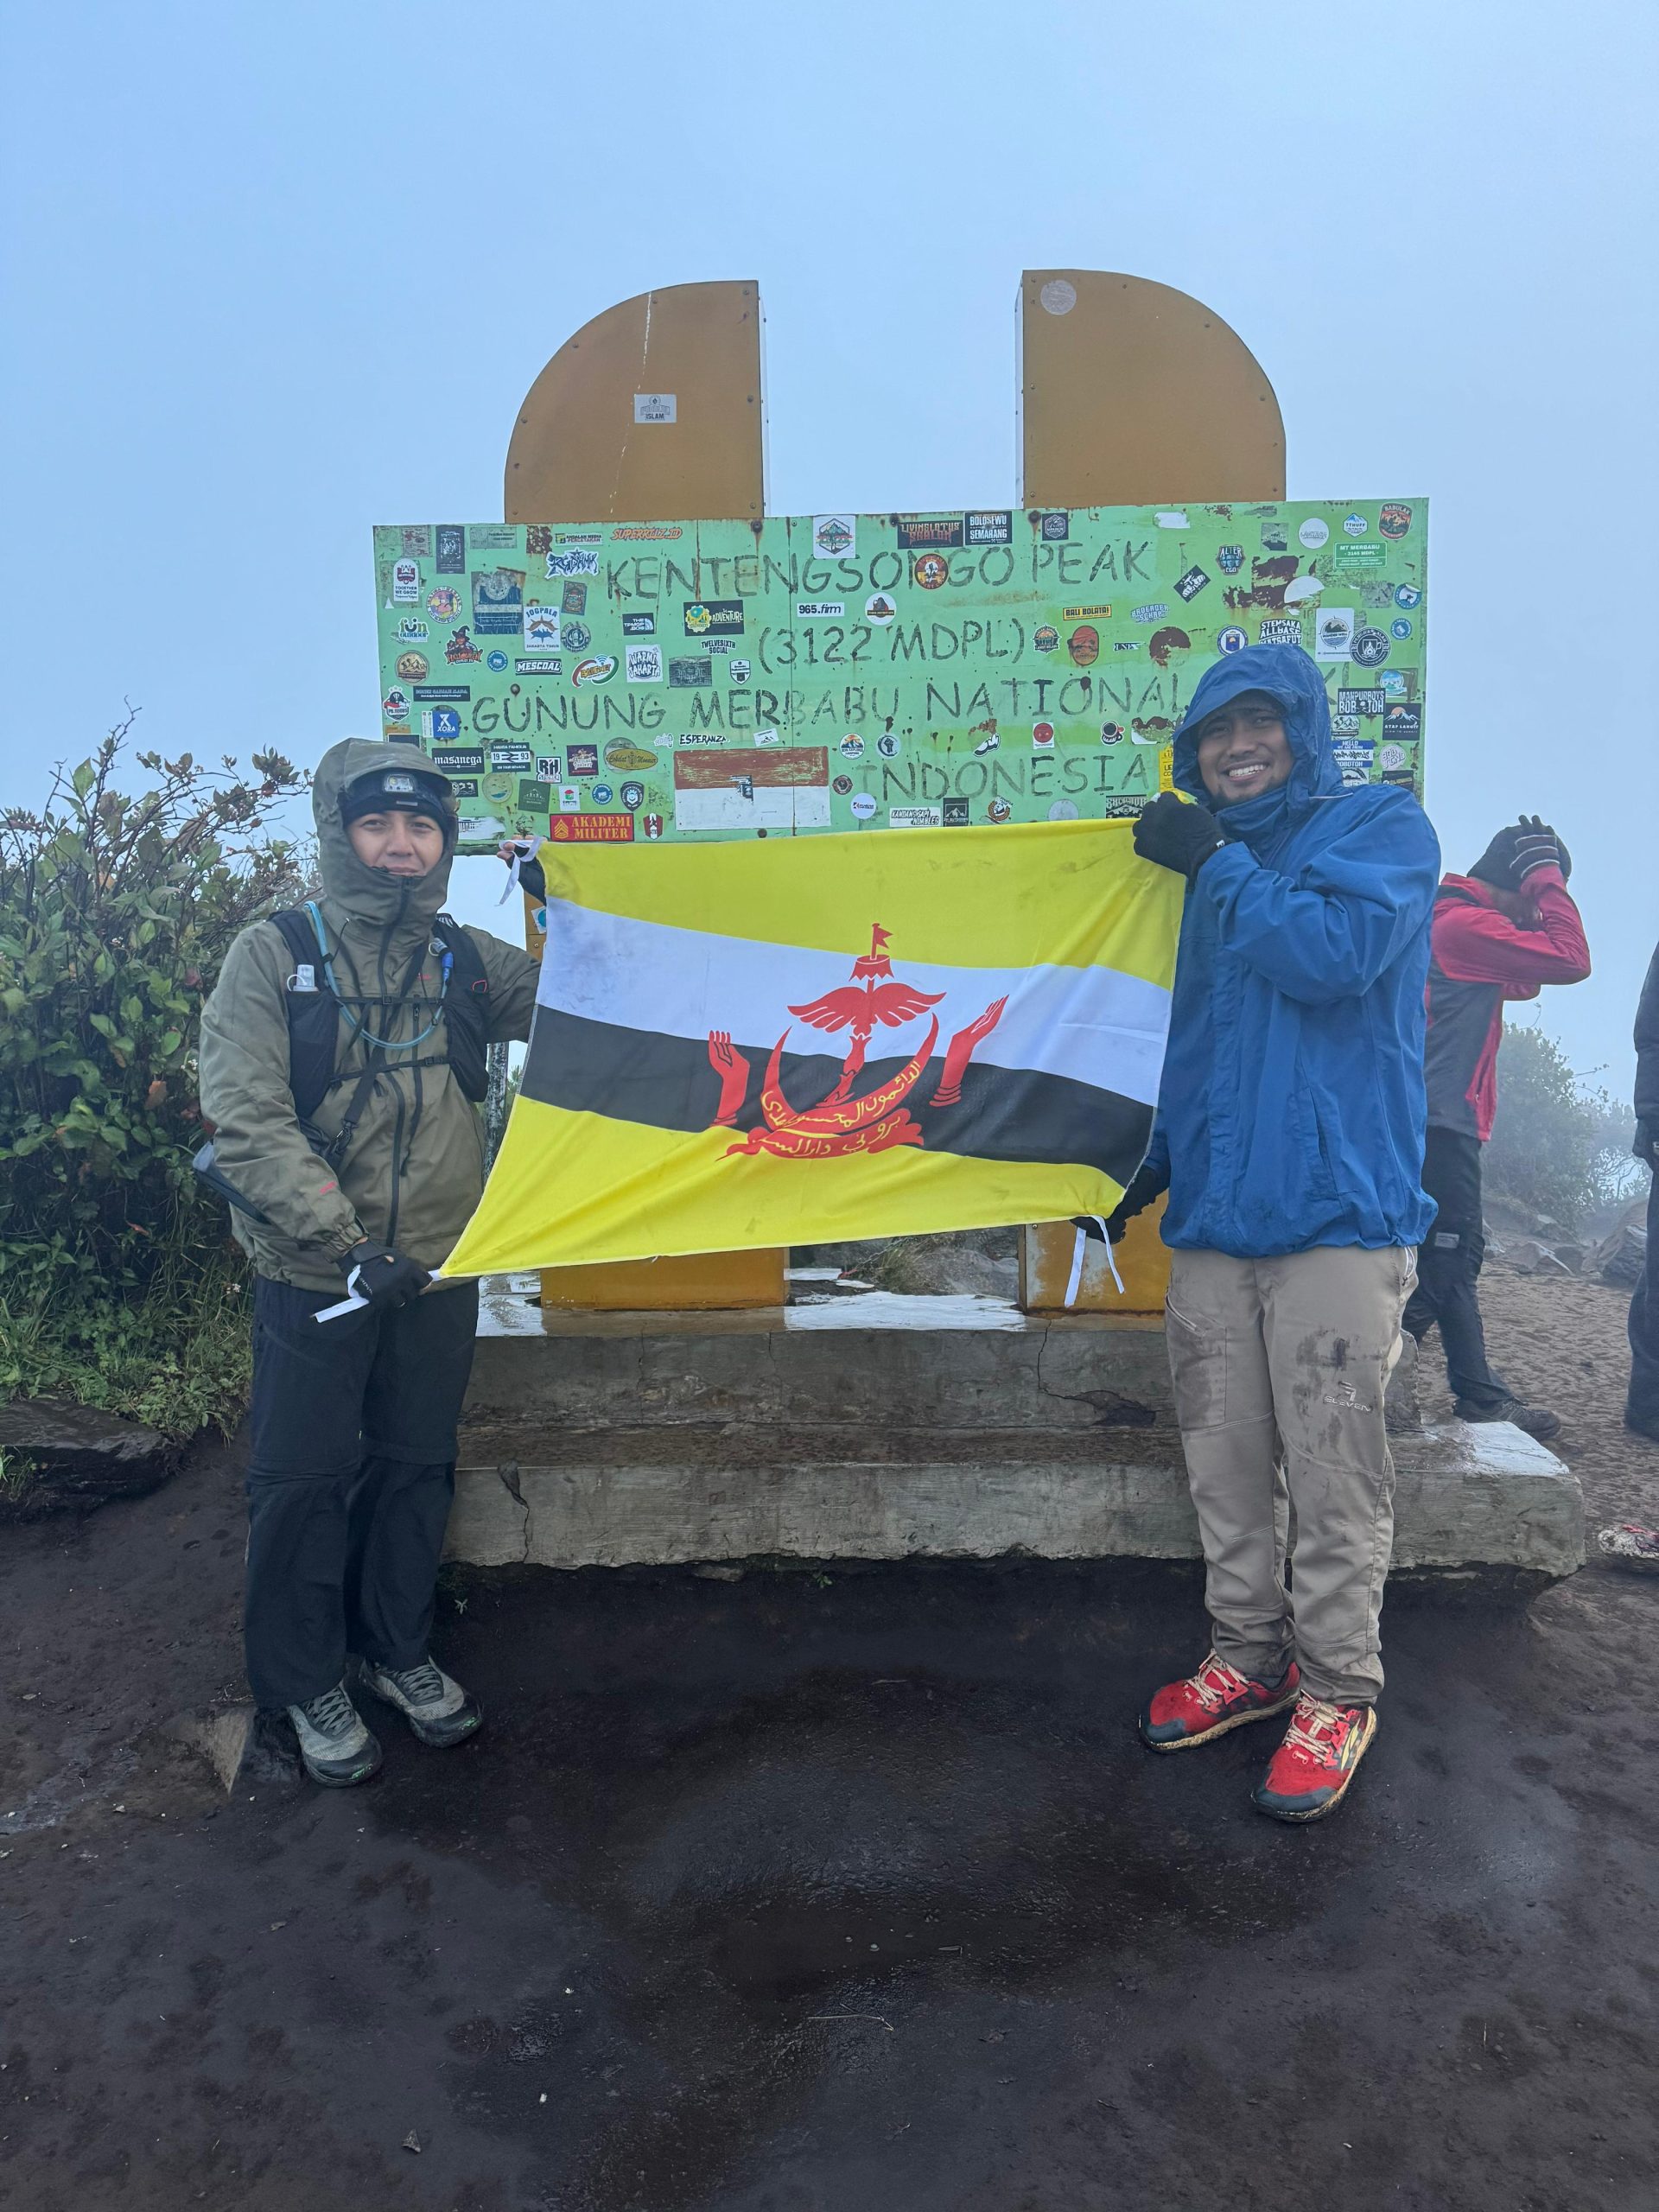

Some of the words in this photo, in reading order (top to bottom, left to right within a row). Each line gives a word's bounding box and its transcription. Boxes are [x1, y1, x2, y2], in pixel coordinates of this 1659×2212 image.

[969, 515, 1007, 526] BOLOSEWU
[969, 528, 1008, 540] SEMARANG
[1220, 545, 1243, 557] ALTER
[1032, 541, 1151, 586] PEAK
[798, 604, 842, 615] 965.firm
[1082, 607, 1109, 616] BOLATA!
[712, 610, 744, 623] ADVENTURE
[1261, 620, 1301, 631] STEMSAKA
[701, 639, 736, 649] TWELVESIXTH
[758, 625, 873, 676] (3122
[890, 617, 1027, 664] MDPL)
[709, 646, 728, 655] SOCIAL
[628, 664, 661, 678] JAKARTA
[1338, 690, 1384, 701] MANPURBOYS
[471, 692, 668, 734] GUNUNG
[690, 685, 899, 730] MERBABU
[925, 672, 1188, 721] NATIONAL
[679, 734, 727, 745] ESPERANZA
[434, 754, 482, 766] masanega
[493, 753, 500, 761] 19
[520, 752, 530, 760] 93
[538, 759, 560, 775] RH
[855, 753, 1150, 803] INDONESIA
[571, 816, 632, 828] AKADEMI
[574, 828, 629, 840] MILITER
[1324, 1395, 1371, 1412] ELEVEN
